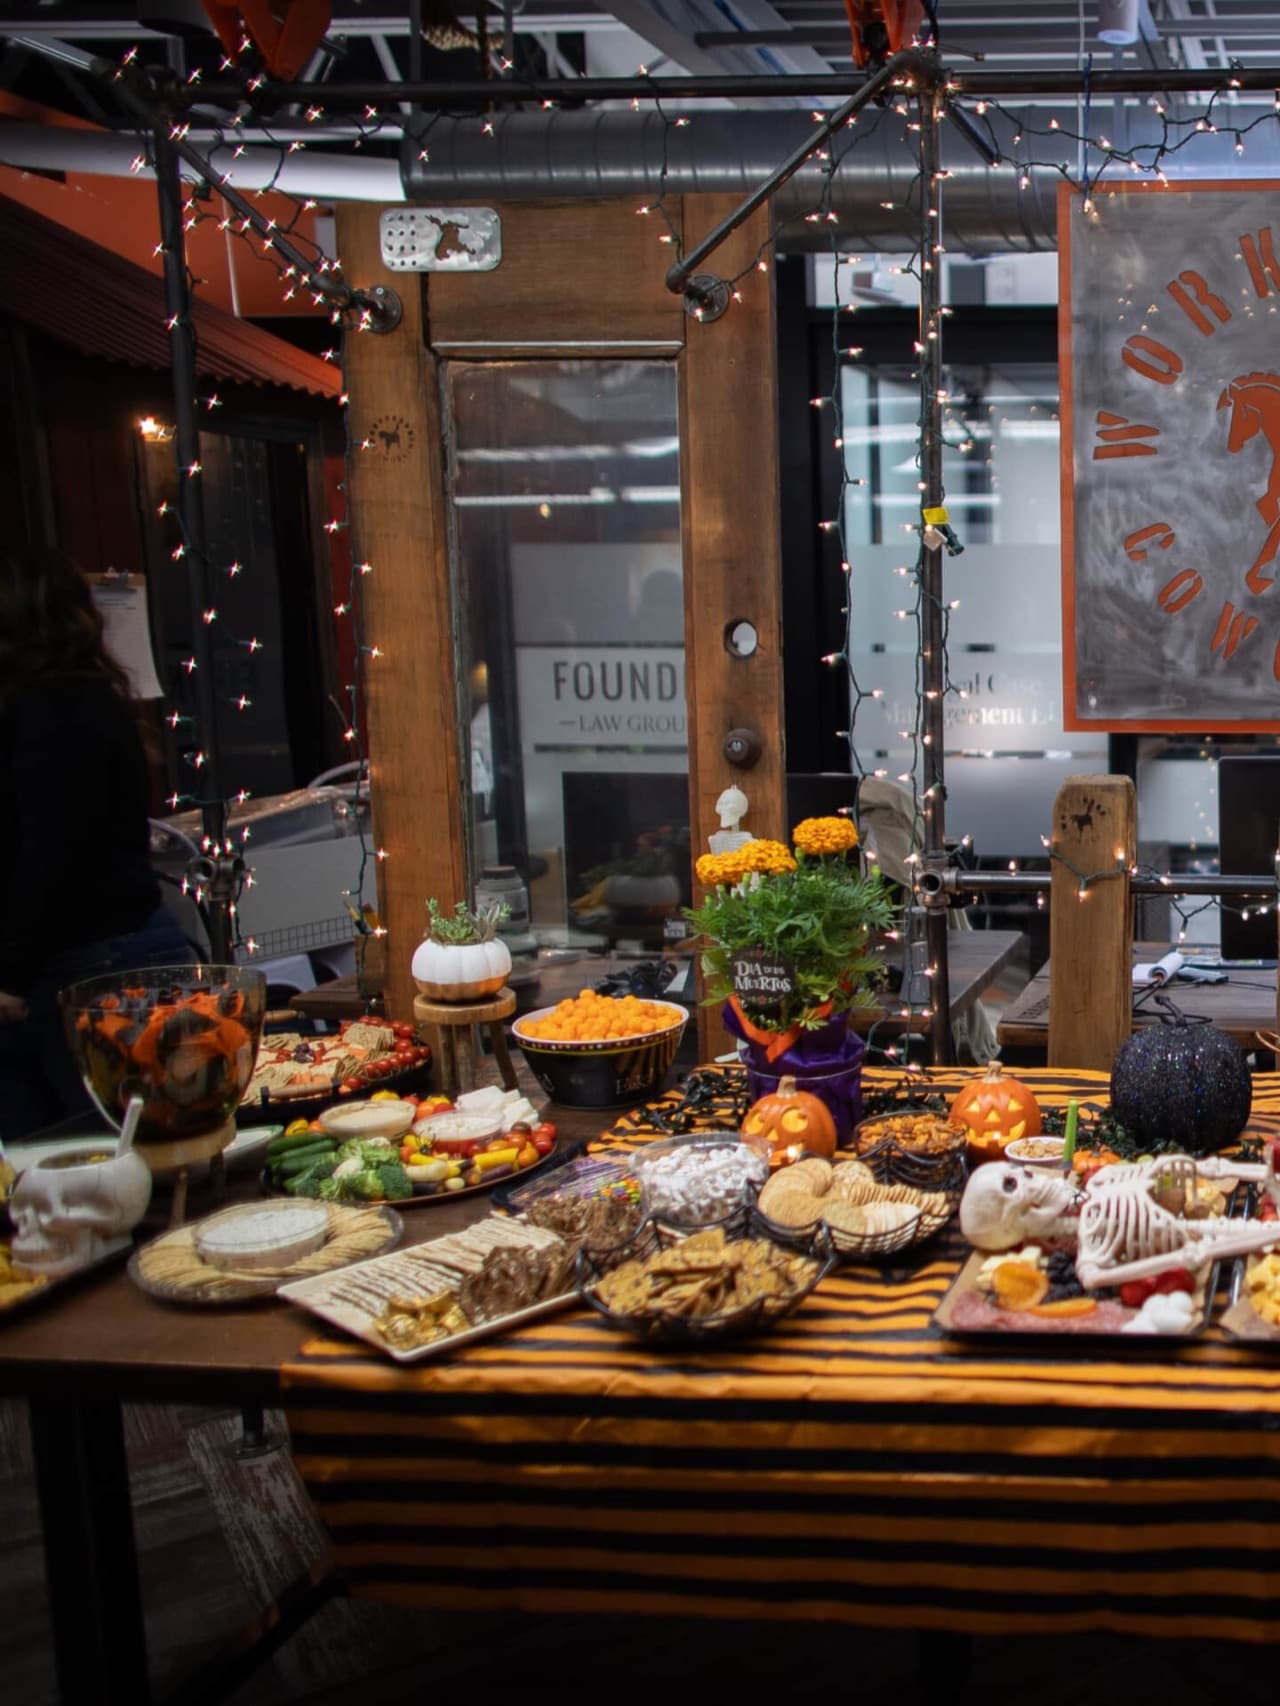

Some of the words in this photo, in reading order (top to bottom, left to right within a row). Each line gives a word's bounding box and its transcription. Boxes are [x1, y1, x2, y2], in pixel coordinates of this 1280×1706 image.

[552, 660, 687, 702] FOUND
[579, 714, 622, 732] LAW
[734, 975, 792, 993] MUERTOS
